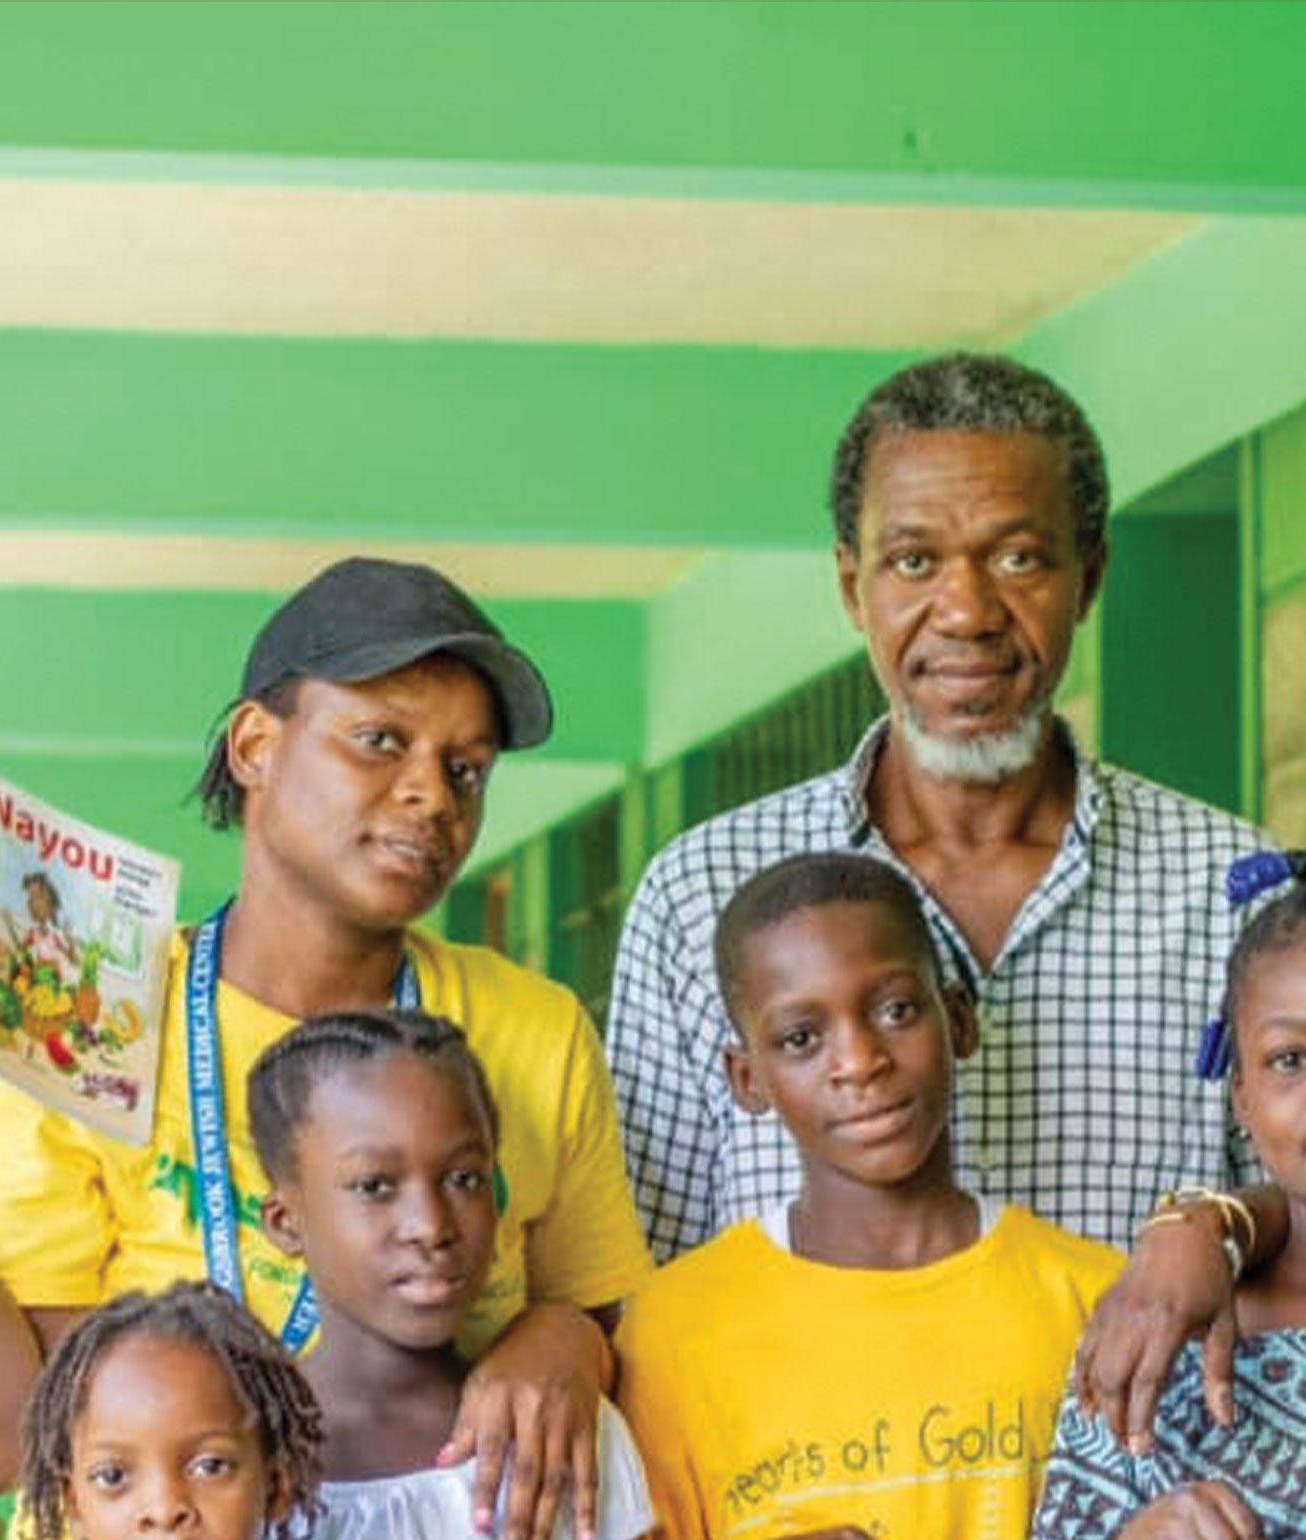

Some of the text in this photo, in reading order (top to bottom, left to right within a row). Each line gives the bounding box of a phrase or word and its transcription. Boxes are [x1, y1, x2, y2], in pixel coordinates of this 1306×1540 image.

[192, 993, 213, 1090] MEDICAL
[841, 1419, 891, 1474] of
[918, 1398, 1025, 1467] Gold
